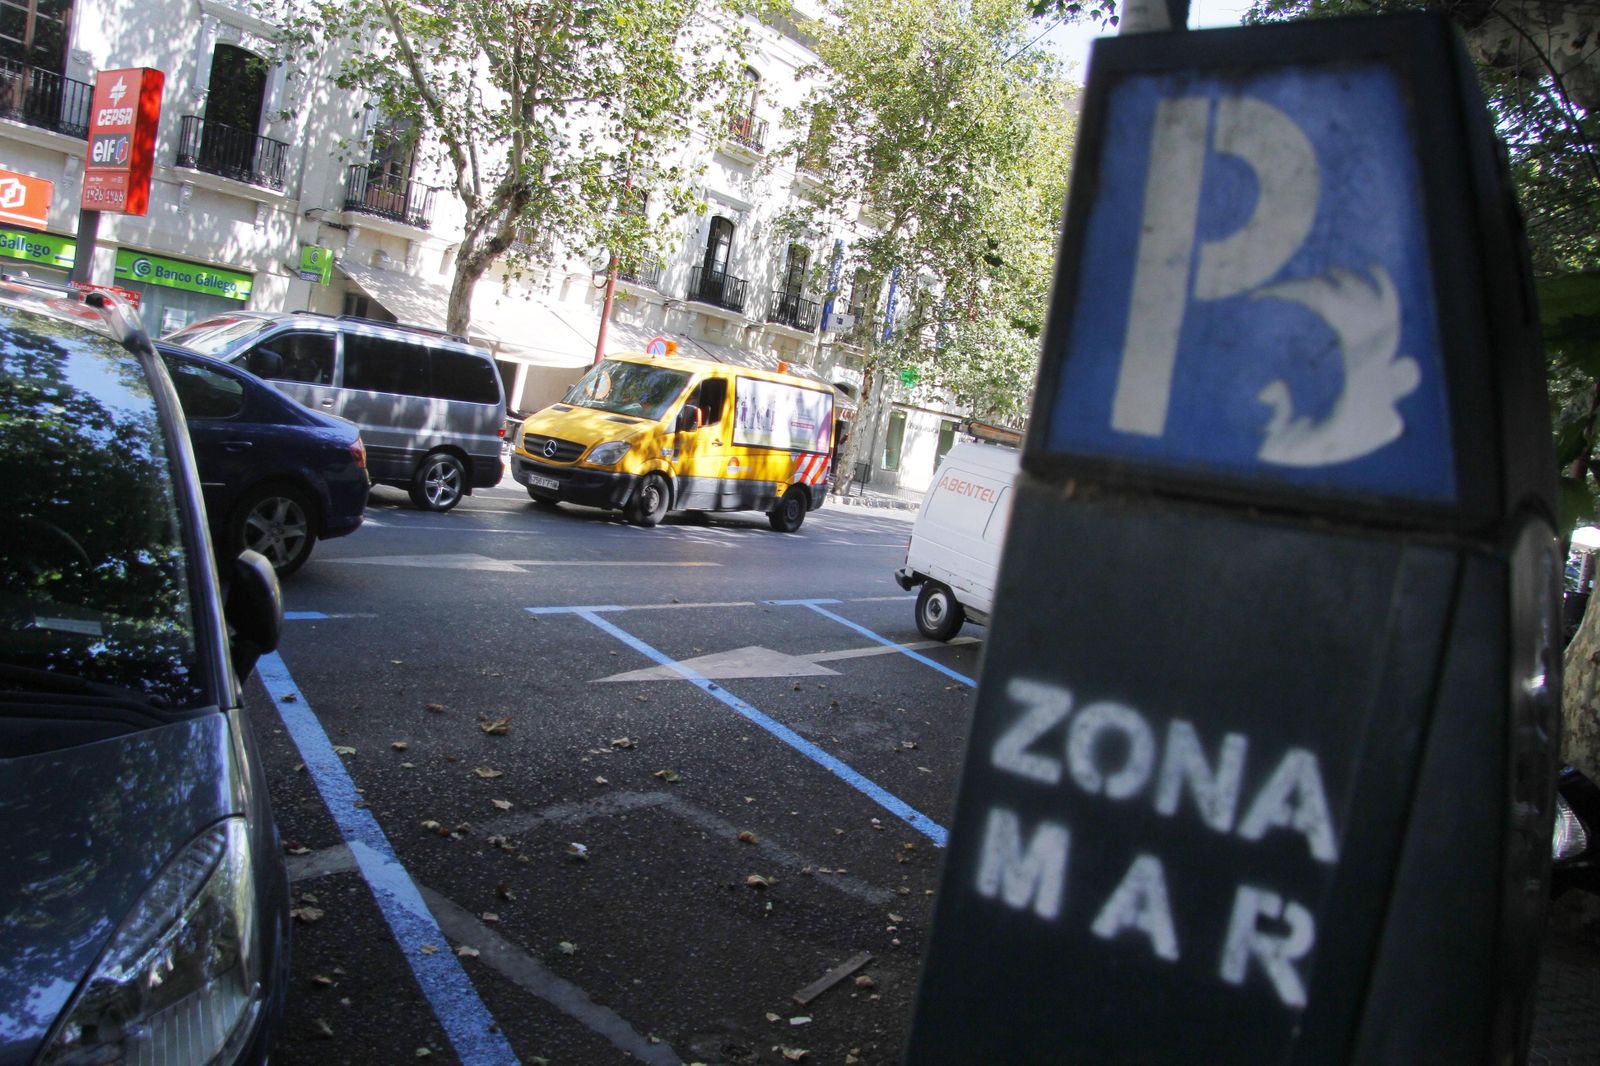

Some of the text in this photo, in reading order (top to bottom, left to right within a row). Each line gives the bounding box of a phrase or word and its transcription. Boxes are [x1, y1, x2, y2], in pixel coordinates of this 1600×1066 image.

[97, 107, 133, 126] CEPSA
[93, 139, 116, 162] elf
[0, 233, 51, 258] Gallego
[155, 265, 237, 293] Banco Gallego
[940, 476, 996, 504] ABENTEL
[991, 677, 1338, 865] ZONA
[976, 806, 1316, 1009] MAR
